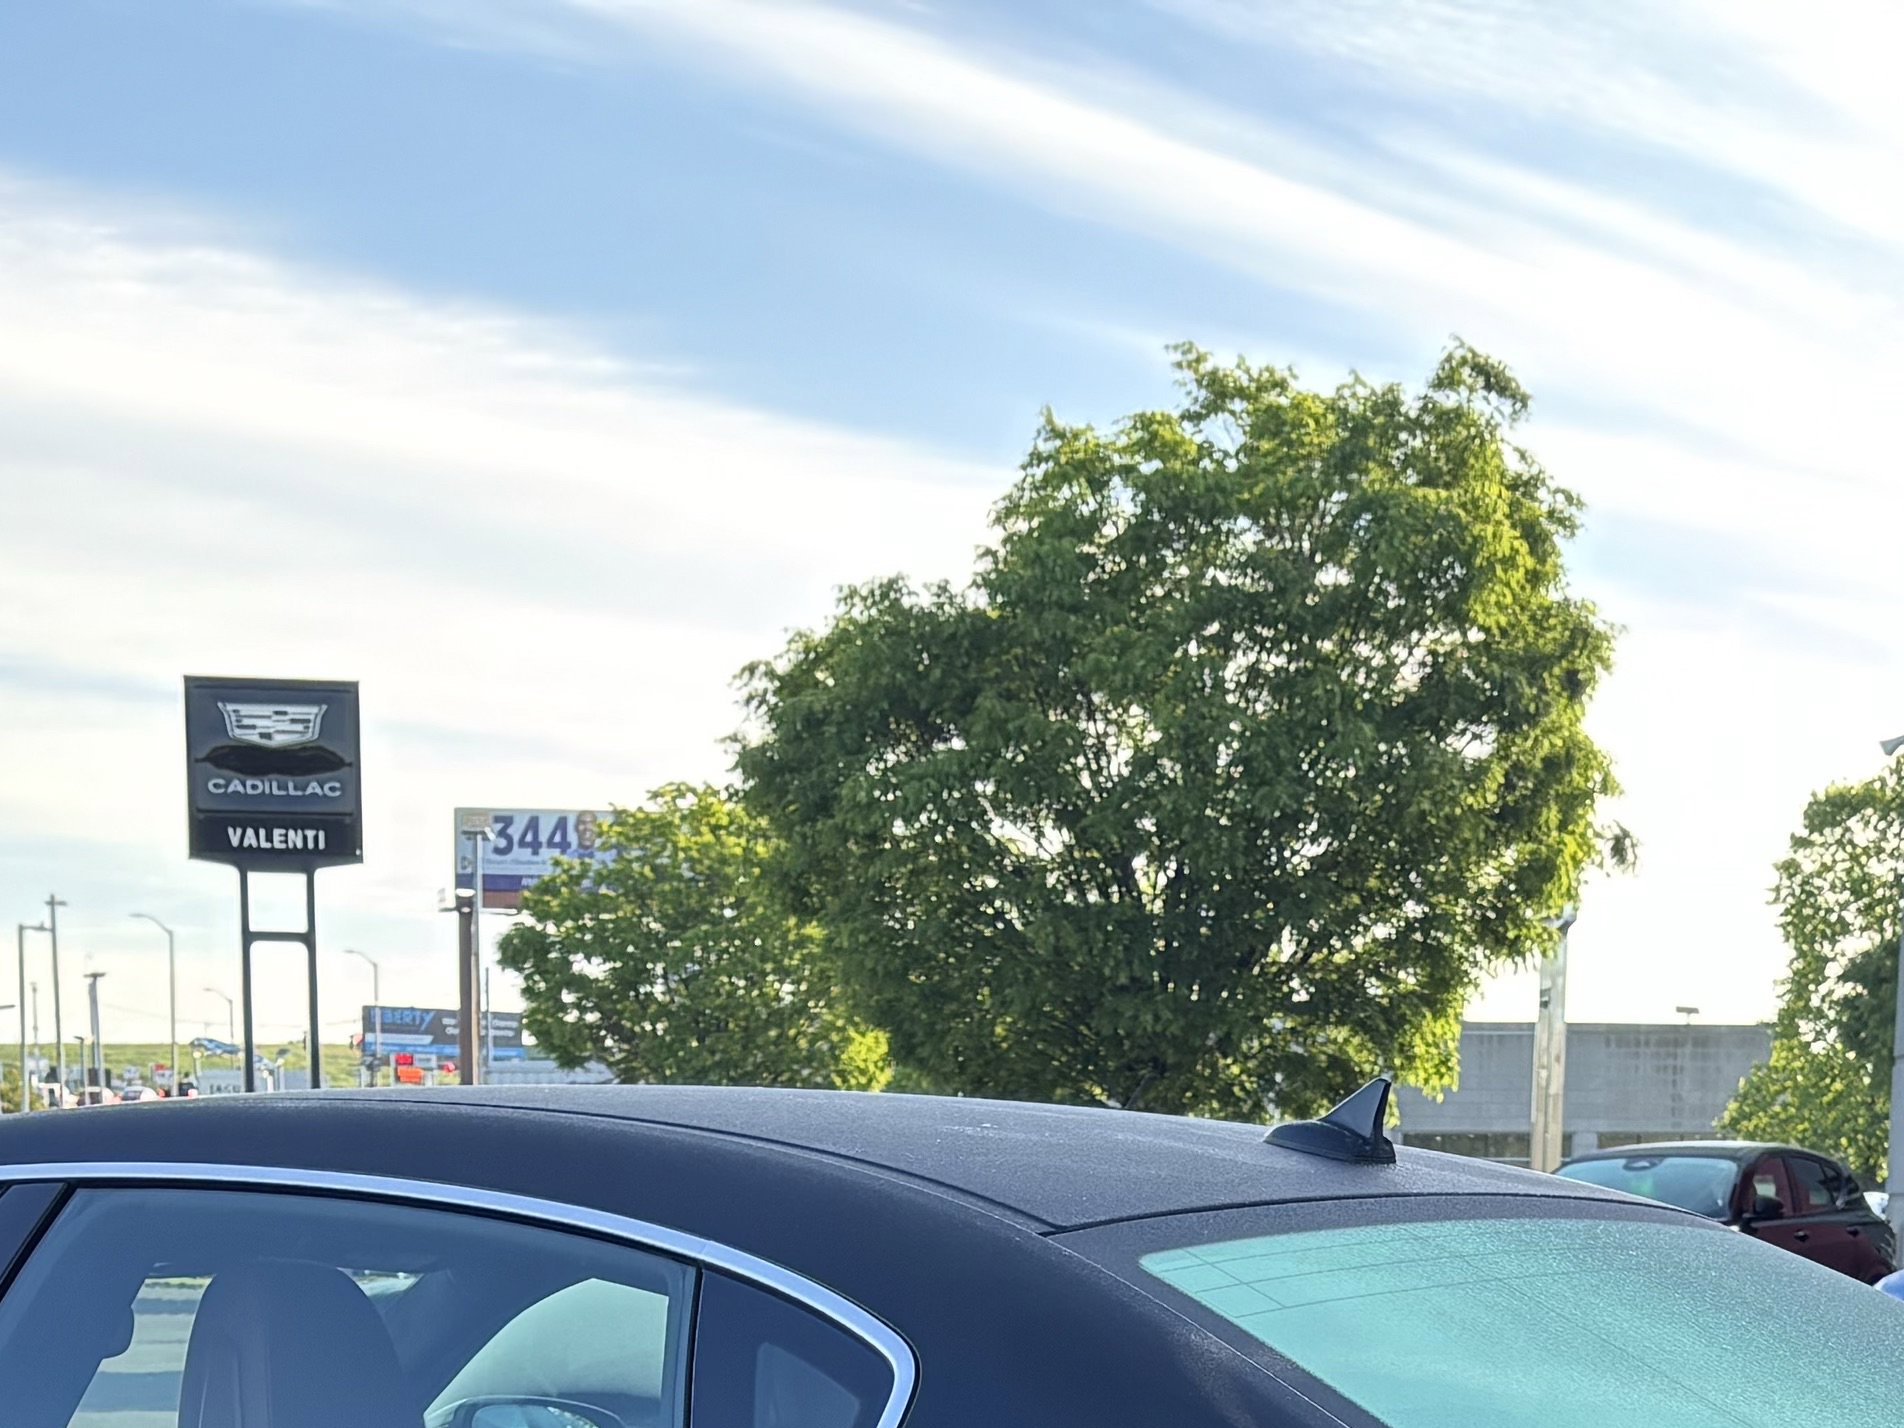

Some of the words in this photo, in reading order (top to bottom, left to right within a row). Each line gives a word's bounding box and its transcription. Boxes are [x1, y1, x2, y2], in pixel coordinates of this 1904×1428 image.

[207, 778, 342, 797] CADILLAC
[227, 826, 326, 850] VALENTI
[491, 815, 571, 856] 344
